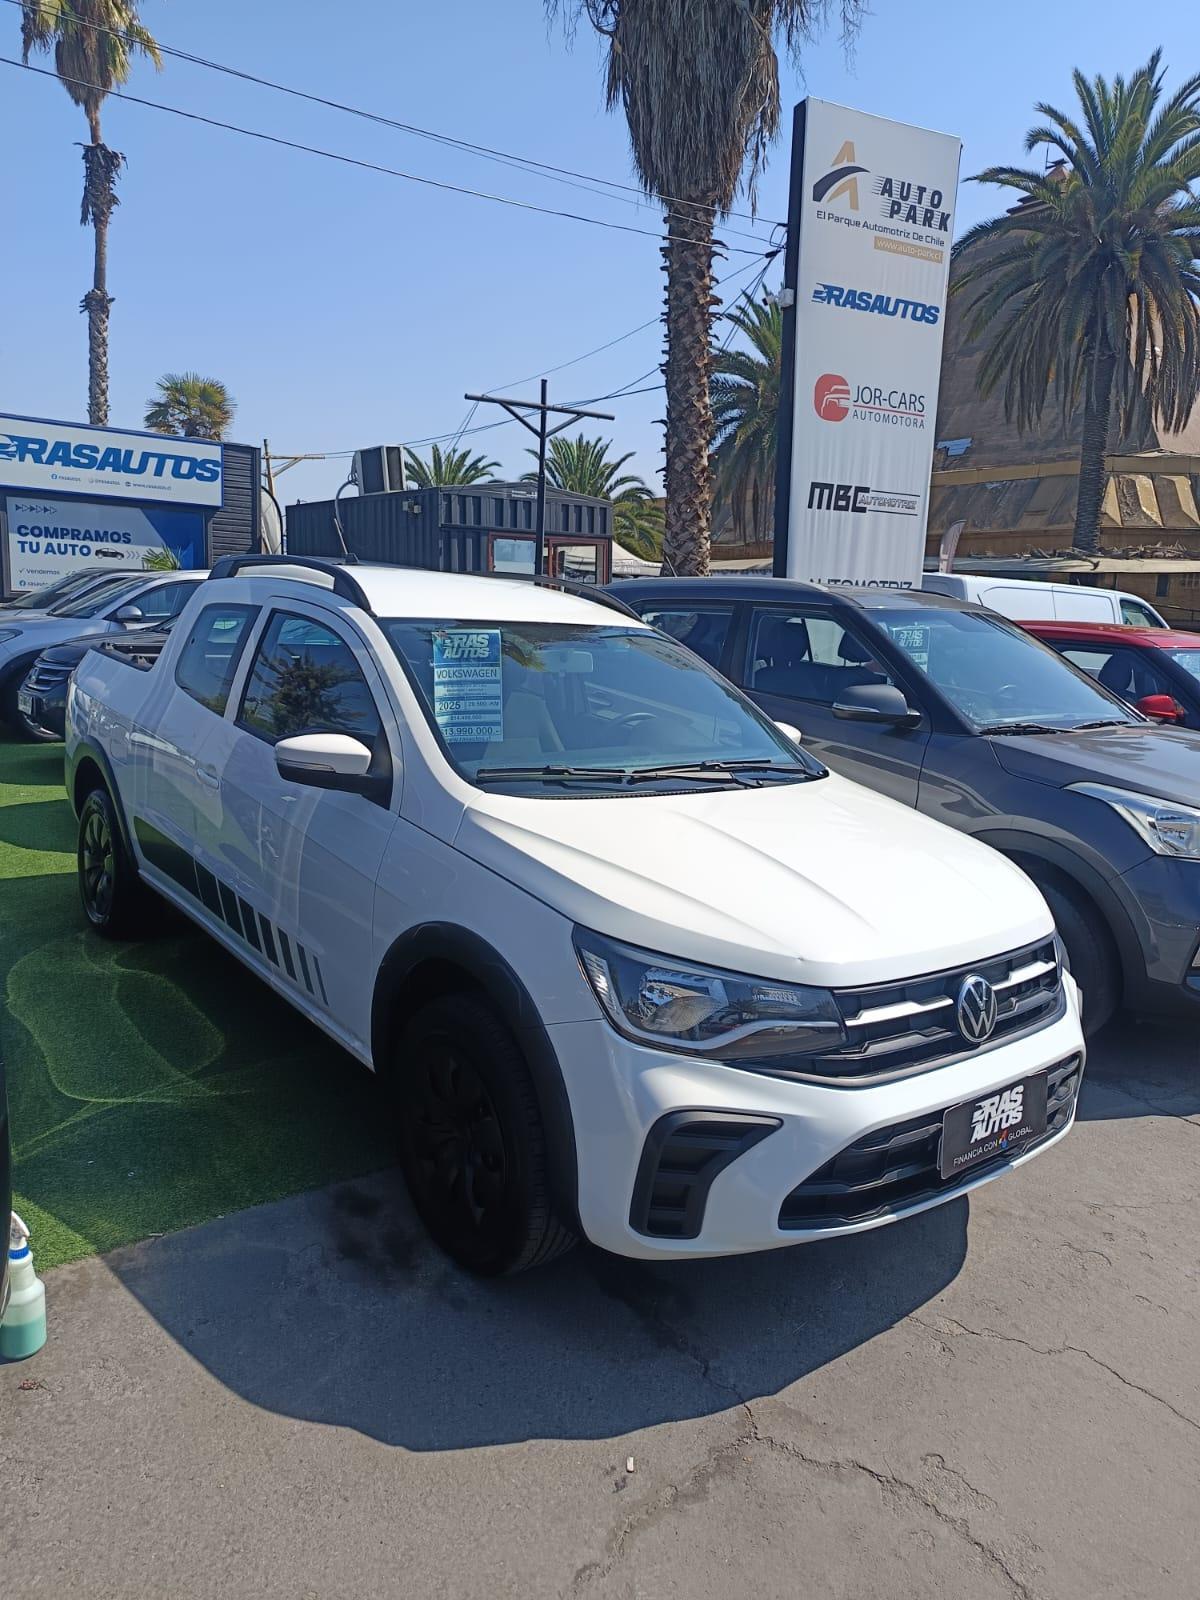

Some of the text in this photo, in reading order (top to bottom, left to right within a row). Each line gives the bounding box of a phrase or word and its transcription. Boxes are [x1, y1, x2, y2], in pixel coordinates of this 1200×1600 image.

[880, 177, 943, 209] AUTO
[816, 210, 945, 247] El Parque Automotriz De Chile
[889, 200, 951, 232] PARK
[820, 283, 940, 325] RASAUTOS
[853, 385, 925, 413] JOR-CARS
[853, 409, 925, 429] AUTOMOTORA
[8, 434, 221, 482] RASAUTOS
[17, 524, 132, 545] COMPRAMOS
[17, 541, 92, 557] TU AUTO
[443, 647, 490, 659] AUTOS
[447, 634, 490, 648] RAS
[436, 668, 497, 679] VOLKSWAGEN
[439, 701, 461, 711] 2025
[979, 1085, 1024, 1120] RAS
[971, 1106, 1024, 1144] AUTOS
[953, 1125, 1033, 1167] FINANCIA CON GLOBAL
